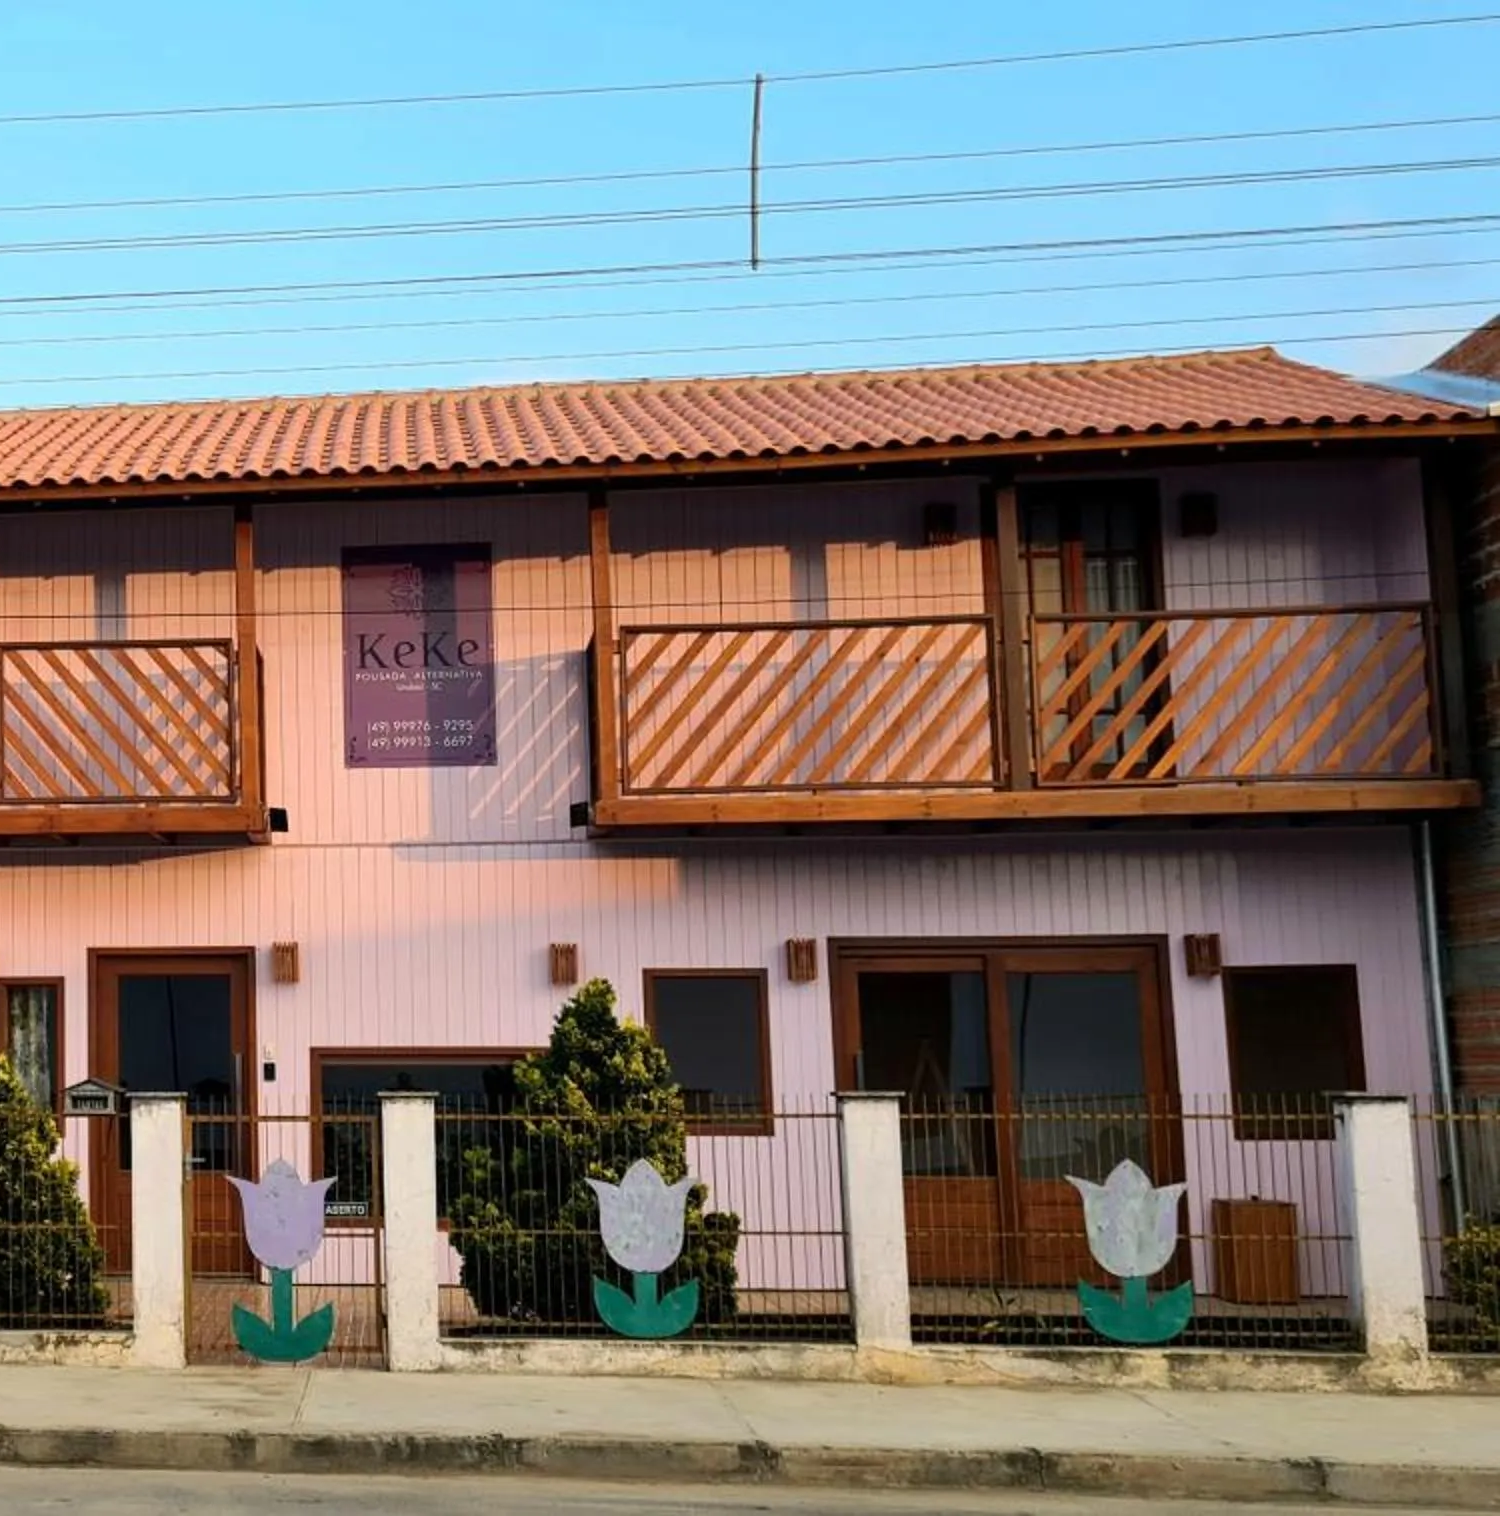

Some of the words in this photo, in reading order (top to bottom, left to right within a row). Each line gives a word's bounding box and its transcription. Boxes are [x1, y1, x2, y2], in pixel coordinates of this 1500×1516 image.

[355, 631, 479, 669] KeKe
[355, 671, 407, 681] POUSADA
[414, 669, 483, 680] ALTERNATIVA
[367, 720, 390, 734] (49)
[443, 719, 473, 731] 9295
[367, 736, 390, 750] (49)
[443, 735, 473, 747] 6697
